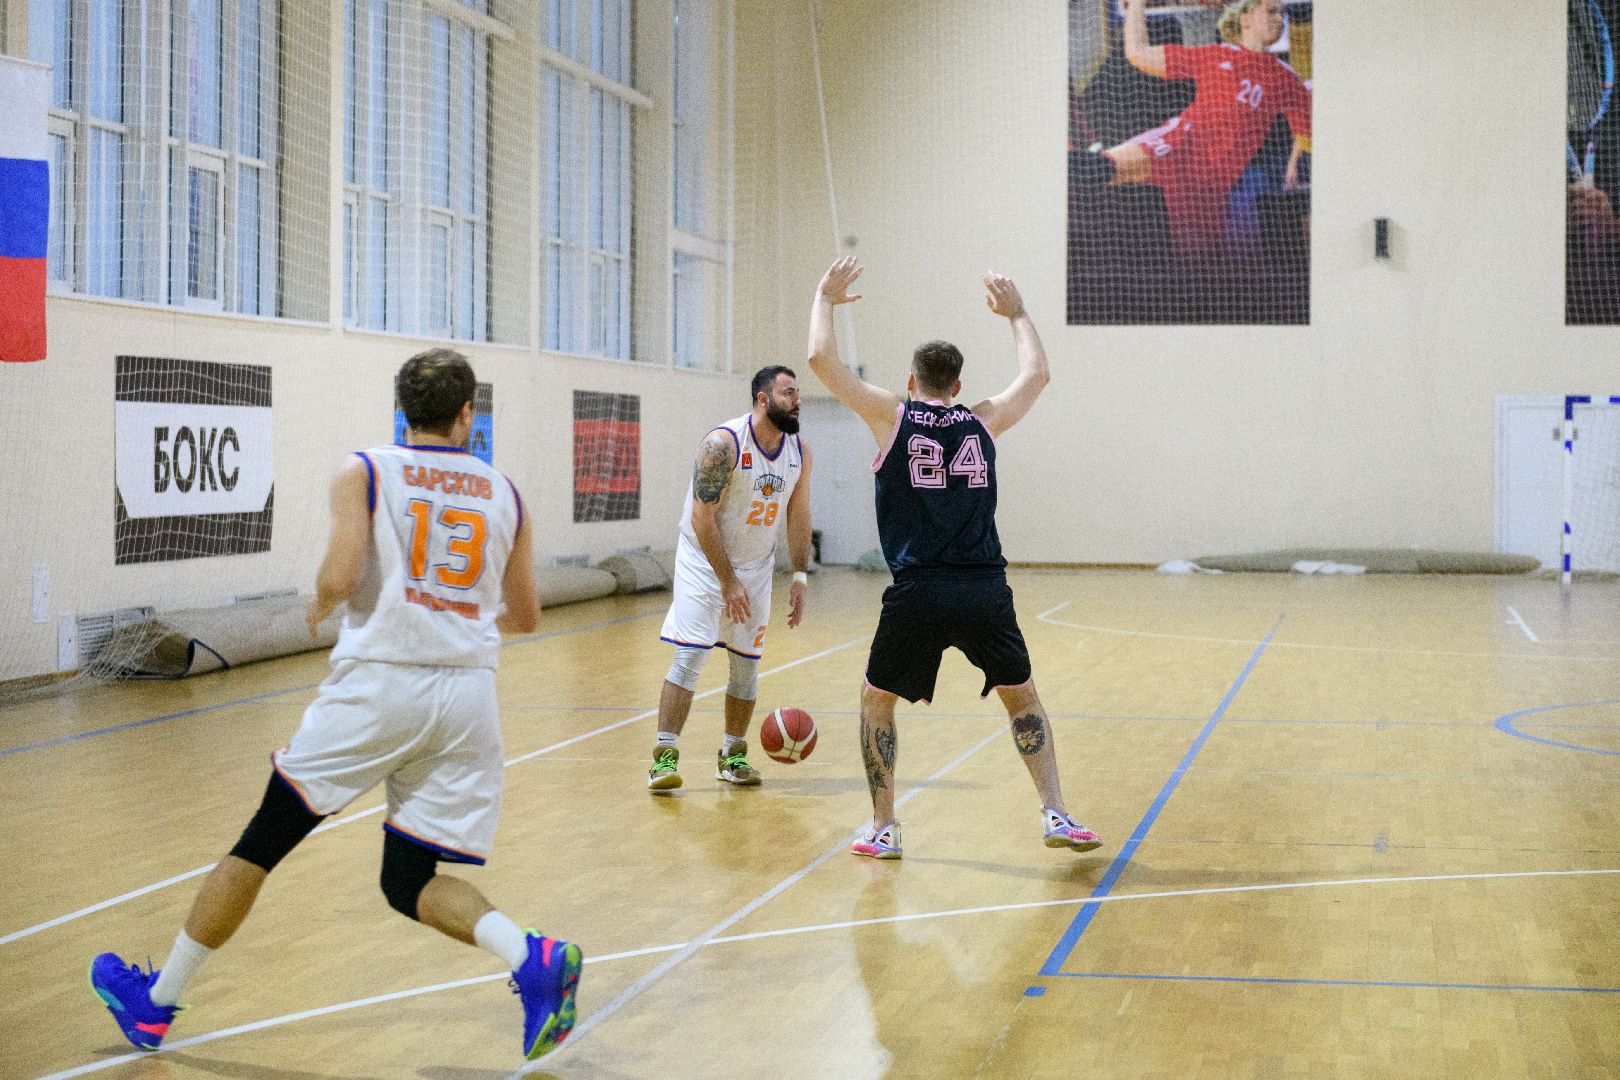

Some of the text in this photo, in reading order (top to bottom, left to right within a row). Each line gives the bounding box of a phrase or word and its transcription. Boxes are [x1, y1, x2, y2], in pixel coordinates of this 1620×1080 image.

[1237, 80, 1264, 108] 20
[154, 426, 240, 493] БОКС
[908, 434, 988, 488] 24
[403, 465, 493, 500] БАРСКОВ
[746, 501, 779, 526] 28
[405, 498, 488, 590] 13
